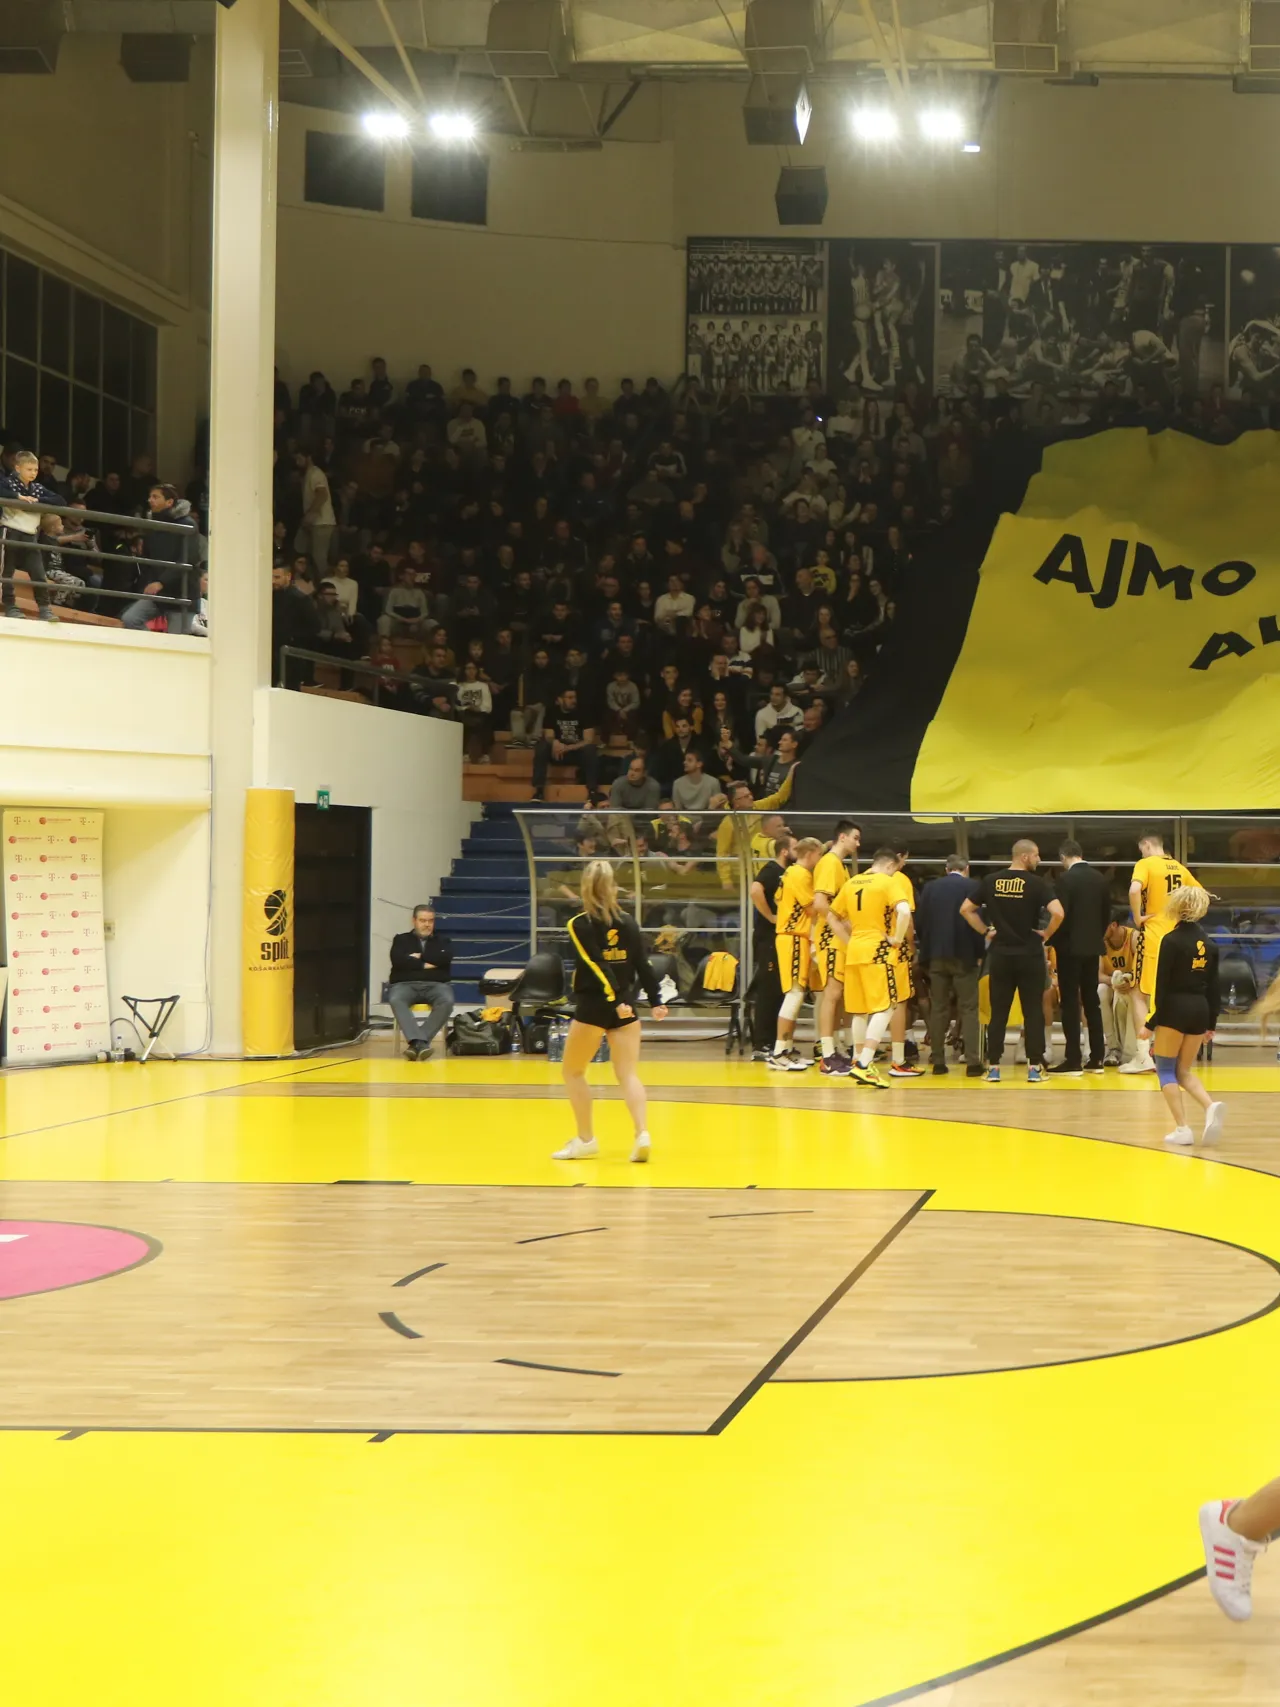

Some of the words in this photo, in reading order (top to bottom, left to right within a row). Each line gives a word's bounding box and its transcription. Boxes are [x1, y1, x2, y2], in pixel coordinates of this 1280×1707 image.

[1032, 532, 1257, 610] AJMO
[1164, 874, 1182, 894] 15
[855, 888, 864, 912] 1
[1111, 956, 1126, 968] 30
